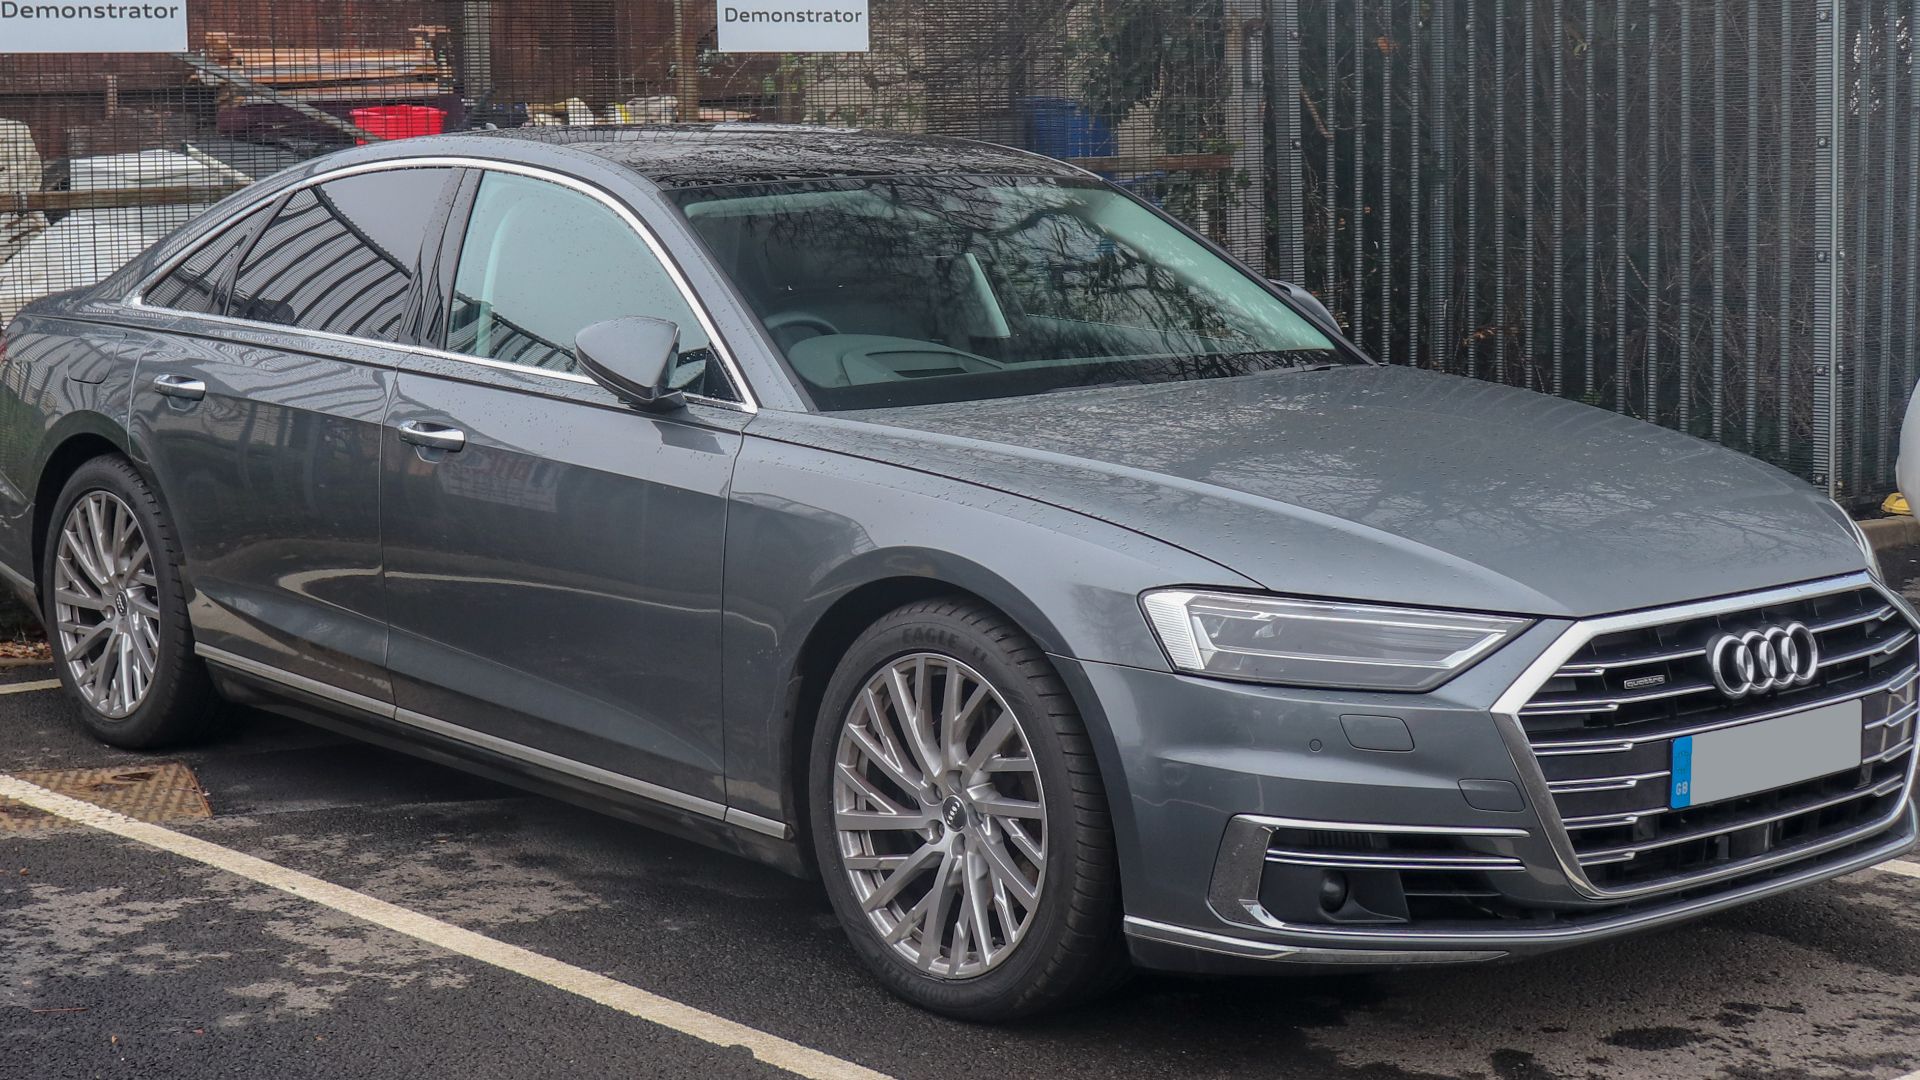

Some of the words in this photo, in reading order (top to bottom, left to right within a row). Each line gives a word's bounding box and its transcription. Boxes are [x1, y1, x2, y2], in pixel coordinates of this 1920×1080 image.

[1, 1, 179, 19] Demonstrator
[724, 7, 862, 23] Demonstrator
[902, 627, 959, 648] EAGLE
[1675, 781, 1689, 796] GB
